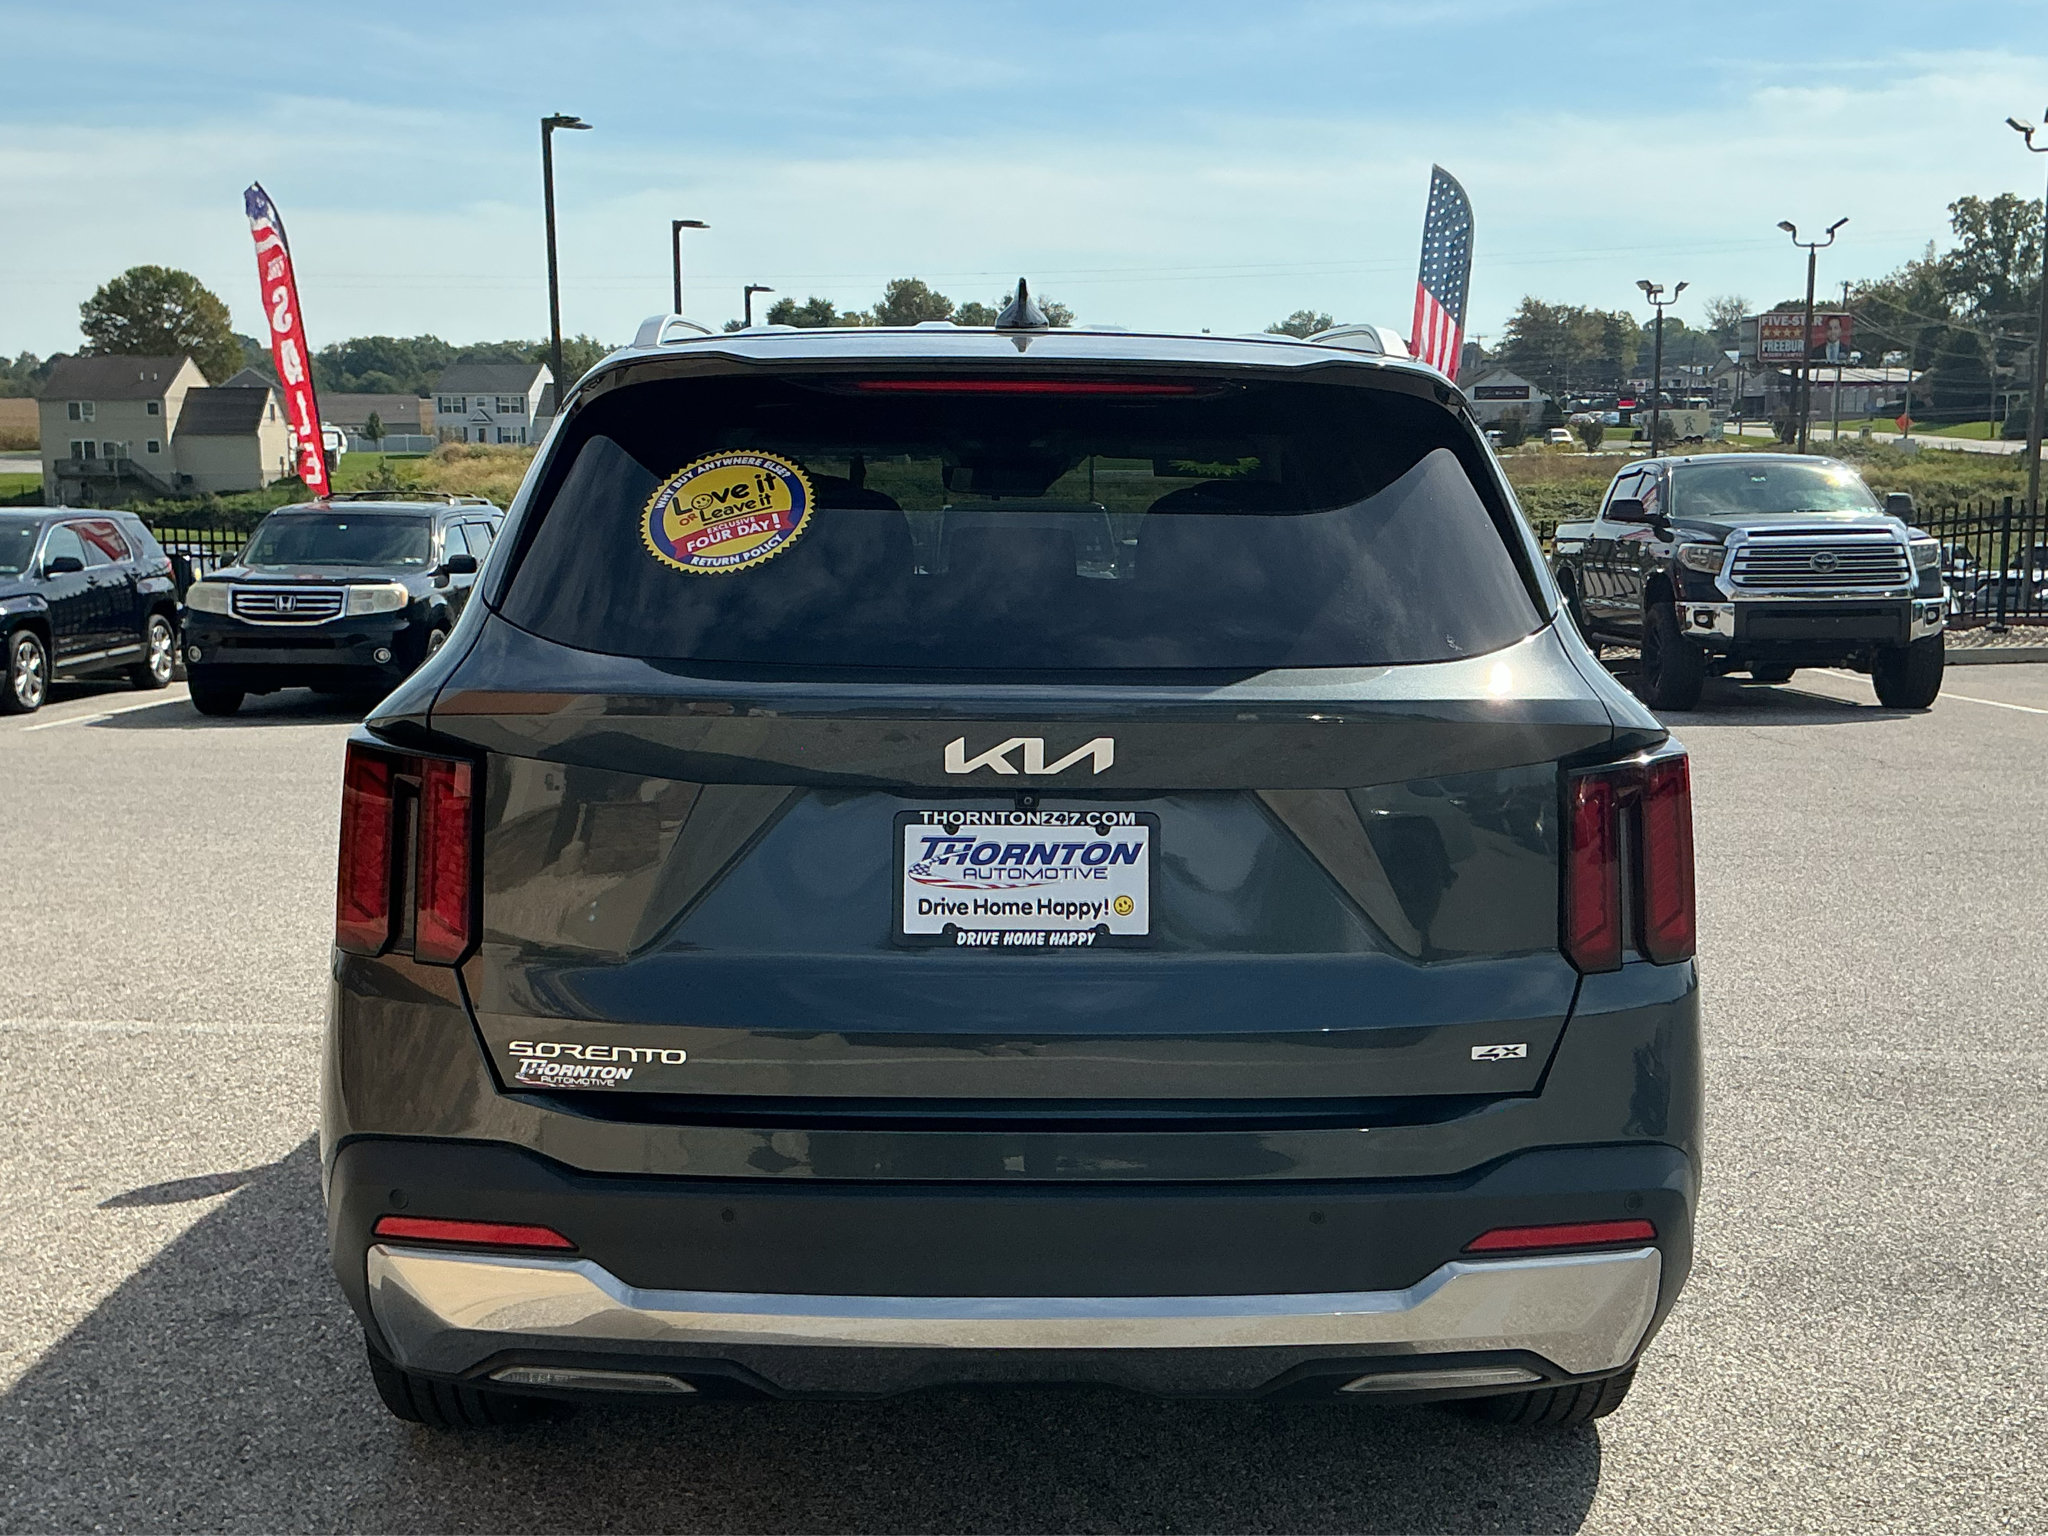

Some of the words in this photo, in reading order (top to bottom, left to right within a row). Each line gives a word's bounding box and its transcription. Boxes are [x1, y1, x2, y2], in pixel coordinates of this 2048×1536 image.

[1762, 315, 1822, 326] FIVE-STR
[1762, 339, 1805, 352] FREEBUR
[655, 488, 674, 509] WHY
[672, 471, 694, 489] BUY
[697, 457, 763, 474] ANYWHERE
[763, 461, 791, 478] ELSE?
[754, 472, 777, 493] it
[699, 499, 757, 522] Leave
[758, 493, 772, 506] it
[679, 513, 698, 526] OR
[706, 516, 756, 534] EXCLUSIVE
[686, 529, 733, 553] FOUR
[690, 556, 740, 567] RETURN
[742, 534, 784, 561] POLICY
[944, 736, 1115, 775] KIA
[920, 835, 1144, 866] THORNTON
[963, 867, 1108, 880] AUTOMOTIVE
[918, 897, 969, 915] Drive
[973, 898, 1034, 915] Home
[1037, 898, 1110, 920] Happy!
[956, 931, 1000, 946] DRIVE
[1003, 931, 1046, 946] HOME
[1049, 931, 1097, 946] HAPPY
[508, 1041, 688, 1065] SORENTO
[518, 1058, 634, 1081] THORNTON
[540, 1075, 616, 1088] AUTOMOTIVE
